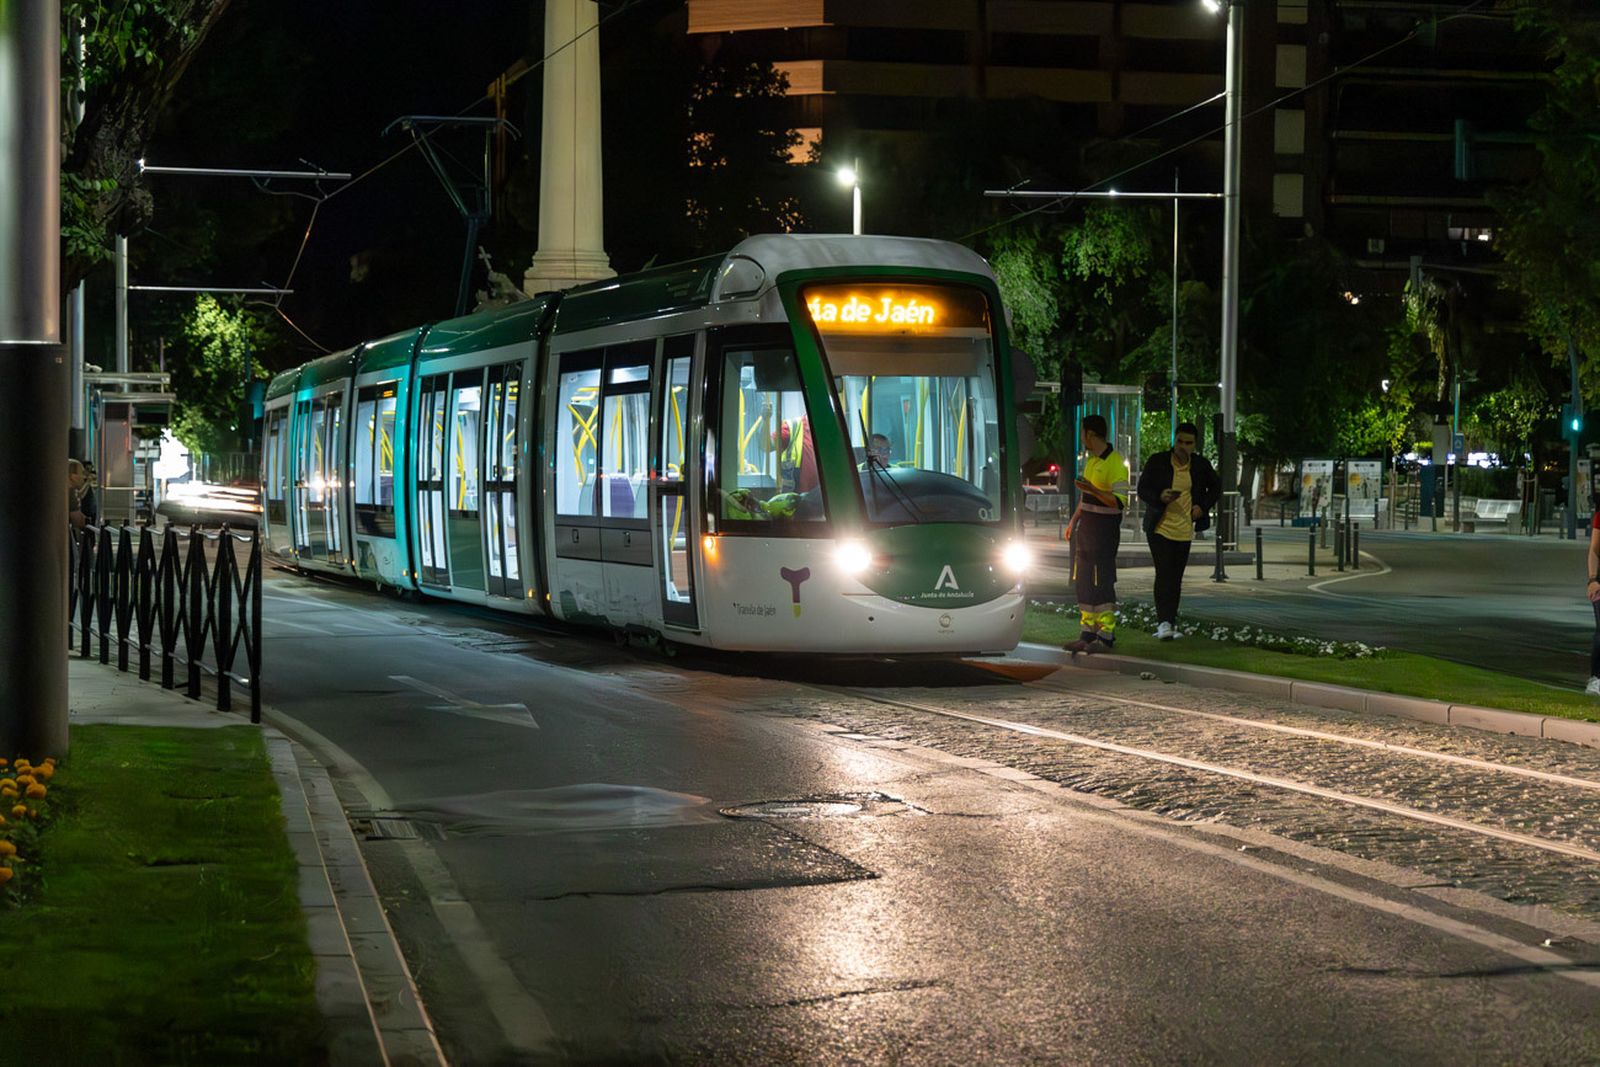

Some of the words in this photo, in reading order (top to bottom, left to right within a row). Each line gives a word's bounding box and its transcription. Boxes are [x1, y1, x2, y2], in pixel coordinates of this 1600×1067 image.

[841, 296, 871, 322] de
[874, 297, 934, 324] Jaén
[920, 591, 937, 599] Junta
